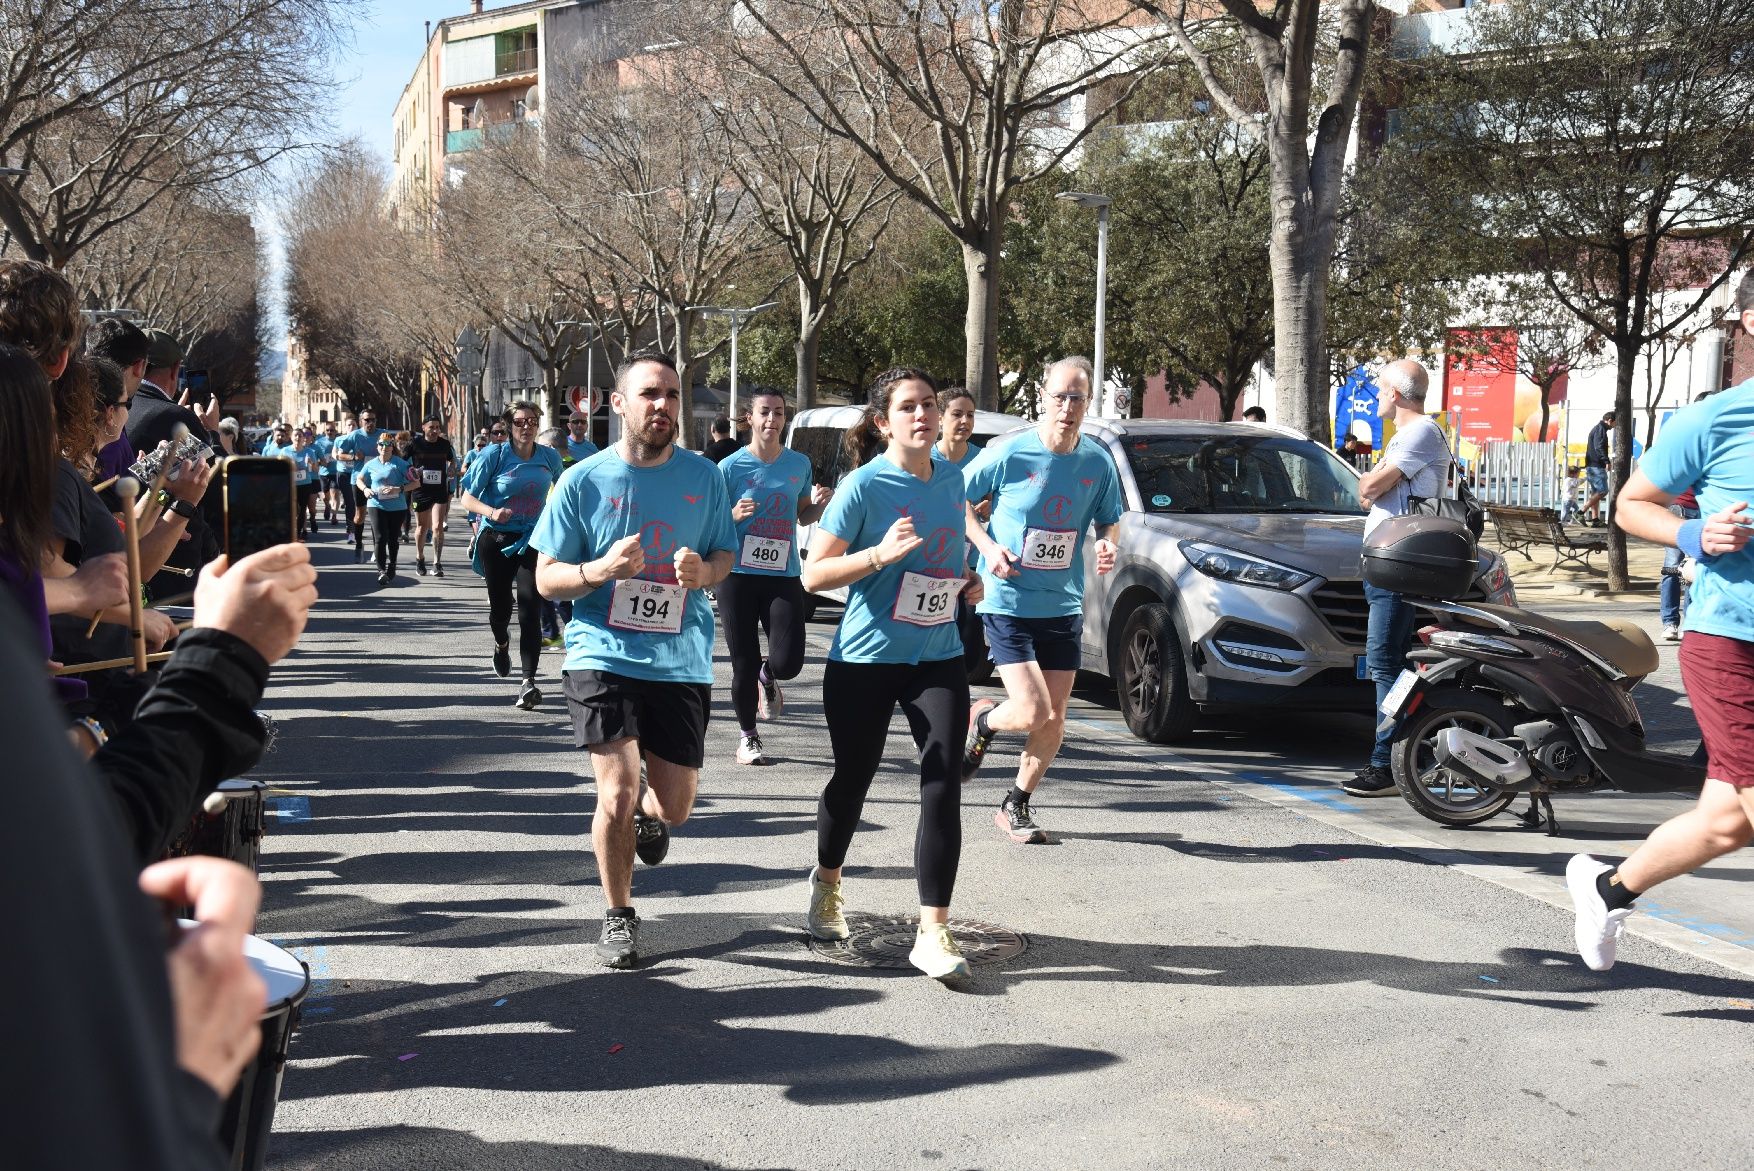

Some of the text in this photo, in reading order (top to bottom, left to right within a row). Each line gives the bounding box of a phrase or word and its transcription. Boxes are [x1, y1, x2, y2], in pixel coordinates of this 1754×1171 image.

[752, 546, 779, 562] 480
[1035, 543, 1066, 559] 346
[630, 595, 670, 619] 194
[916, 592, 948, 613] 193
